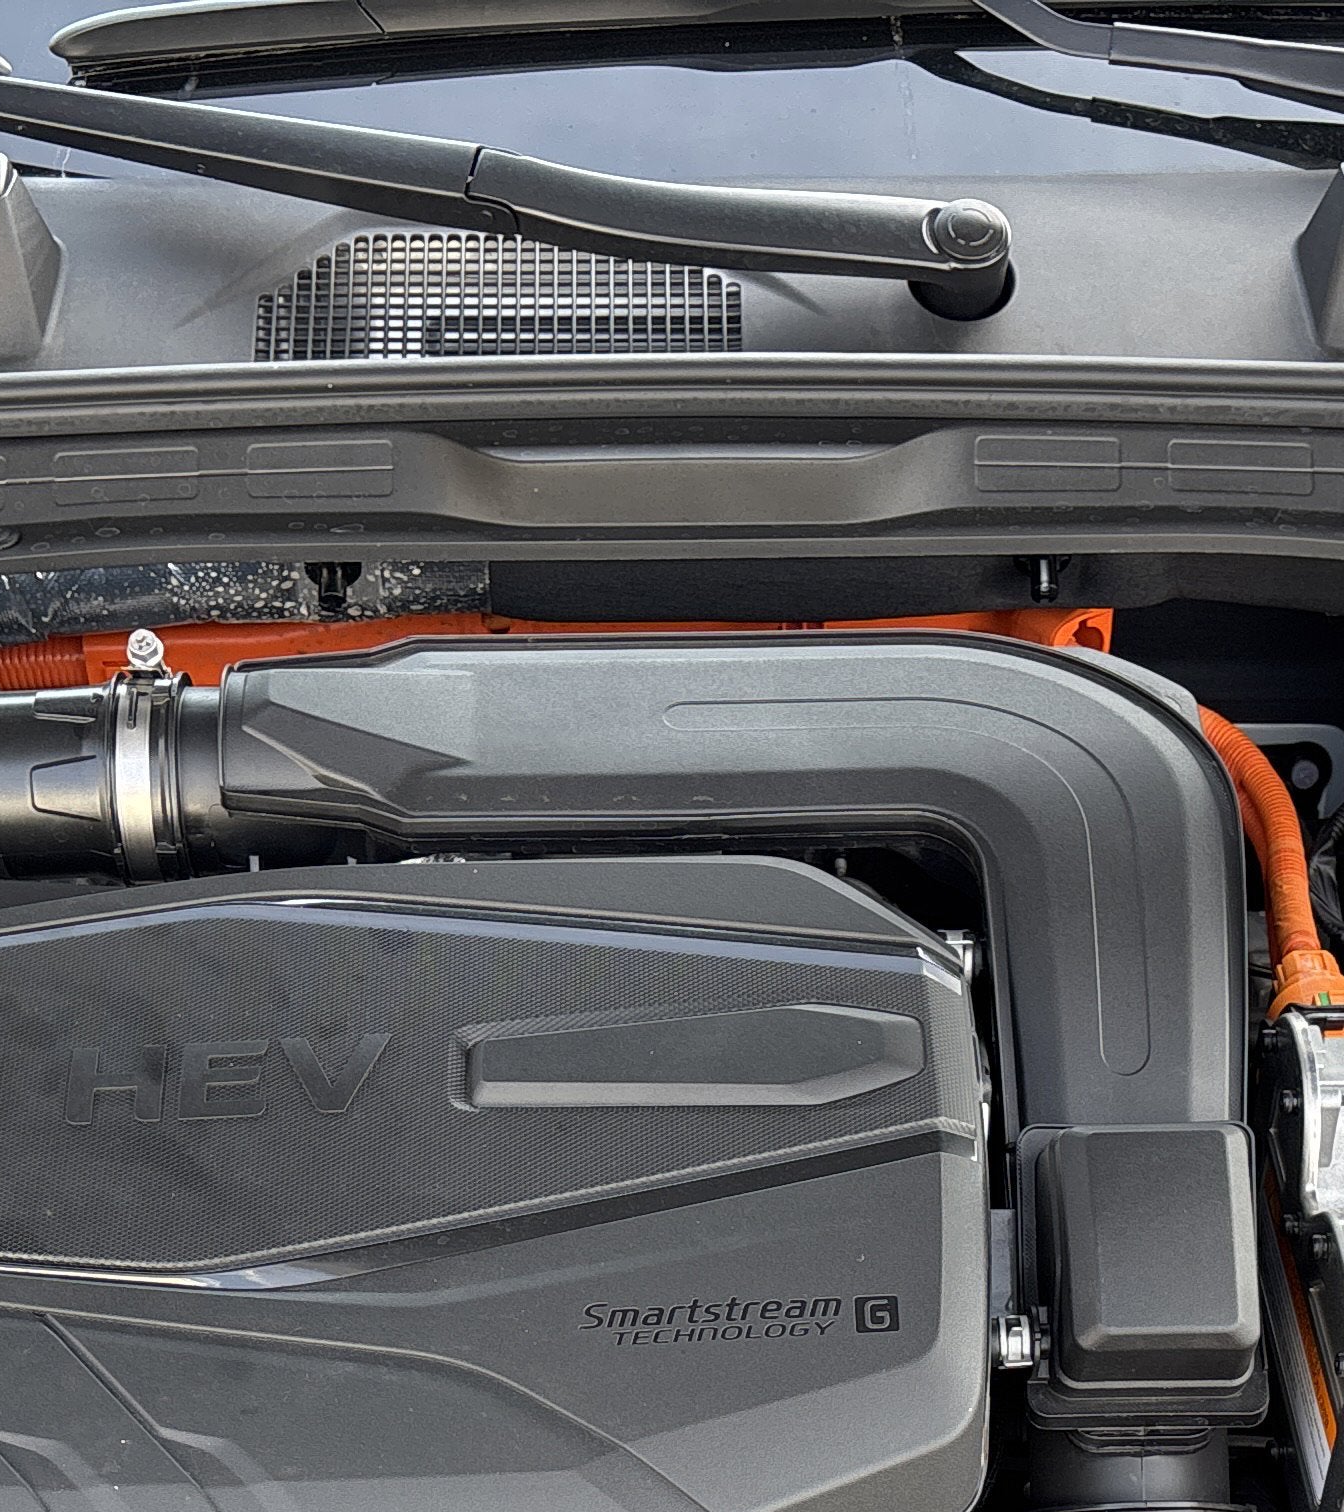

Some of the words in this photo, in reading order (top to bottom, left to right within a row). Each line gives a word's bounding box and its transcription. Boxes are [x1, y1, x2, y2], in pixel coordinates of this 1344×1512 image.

[65, 1032, 392, 1125] HEV
[579, 1297, 842, 1329] Smartstream
[612, 1321, 835, 1346] TECHNOLOGY
